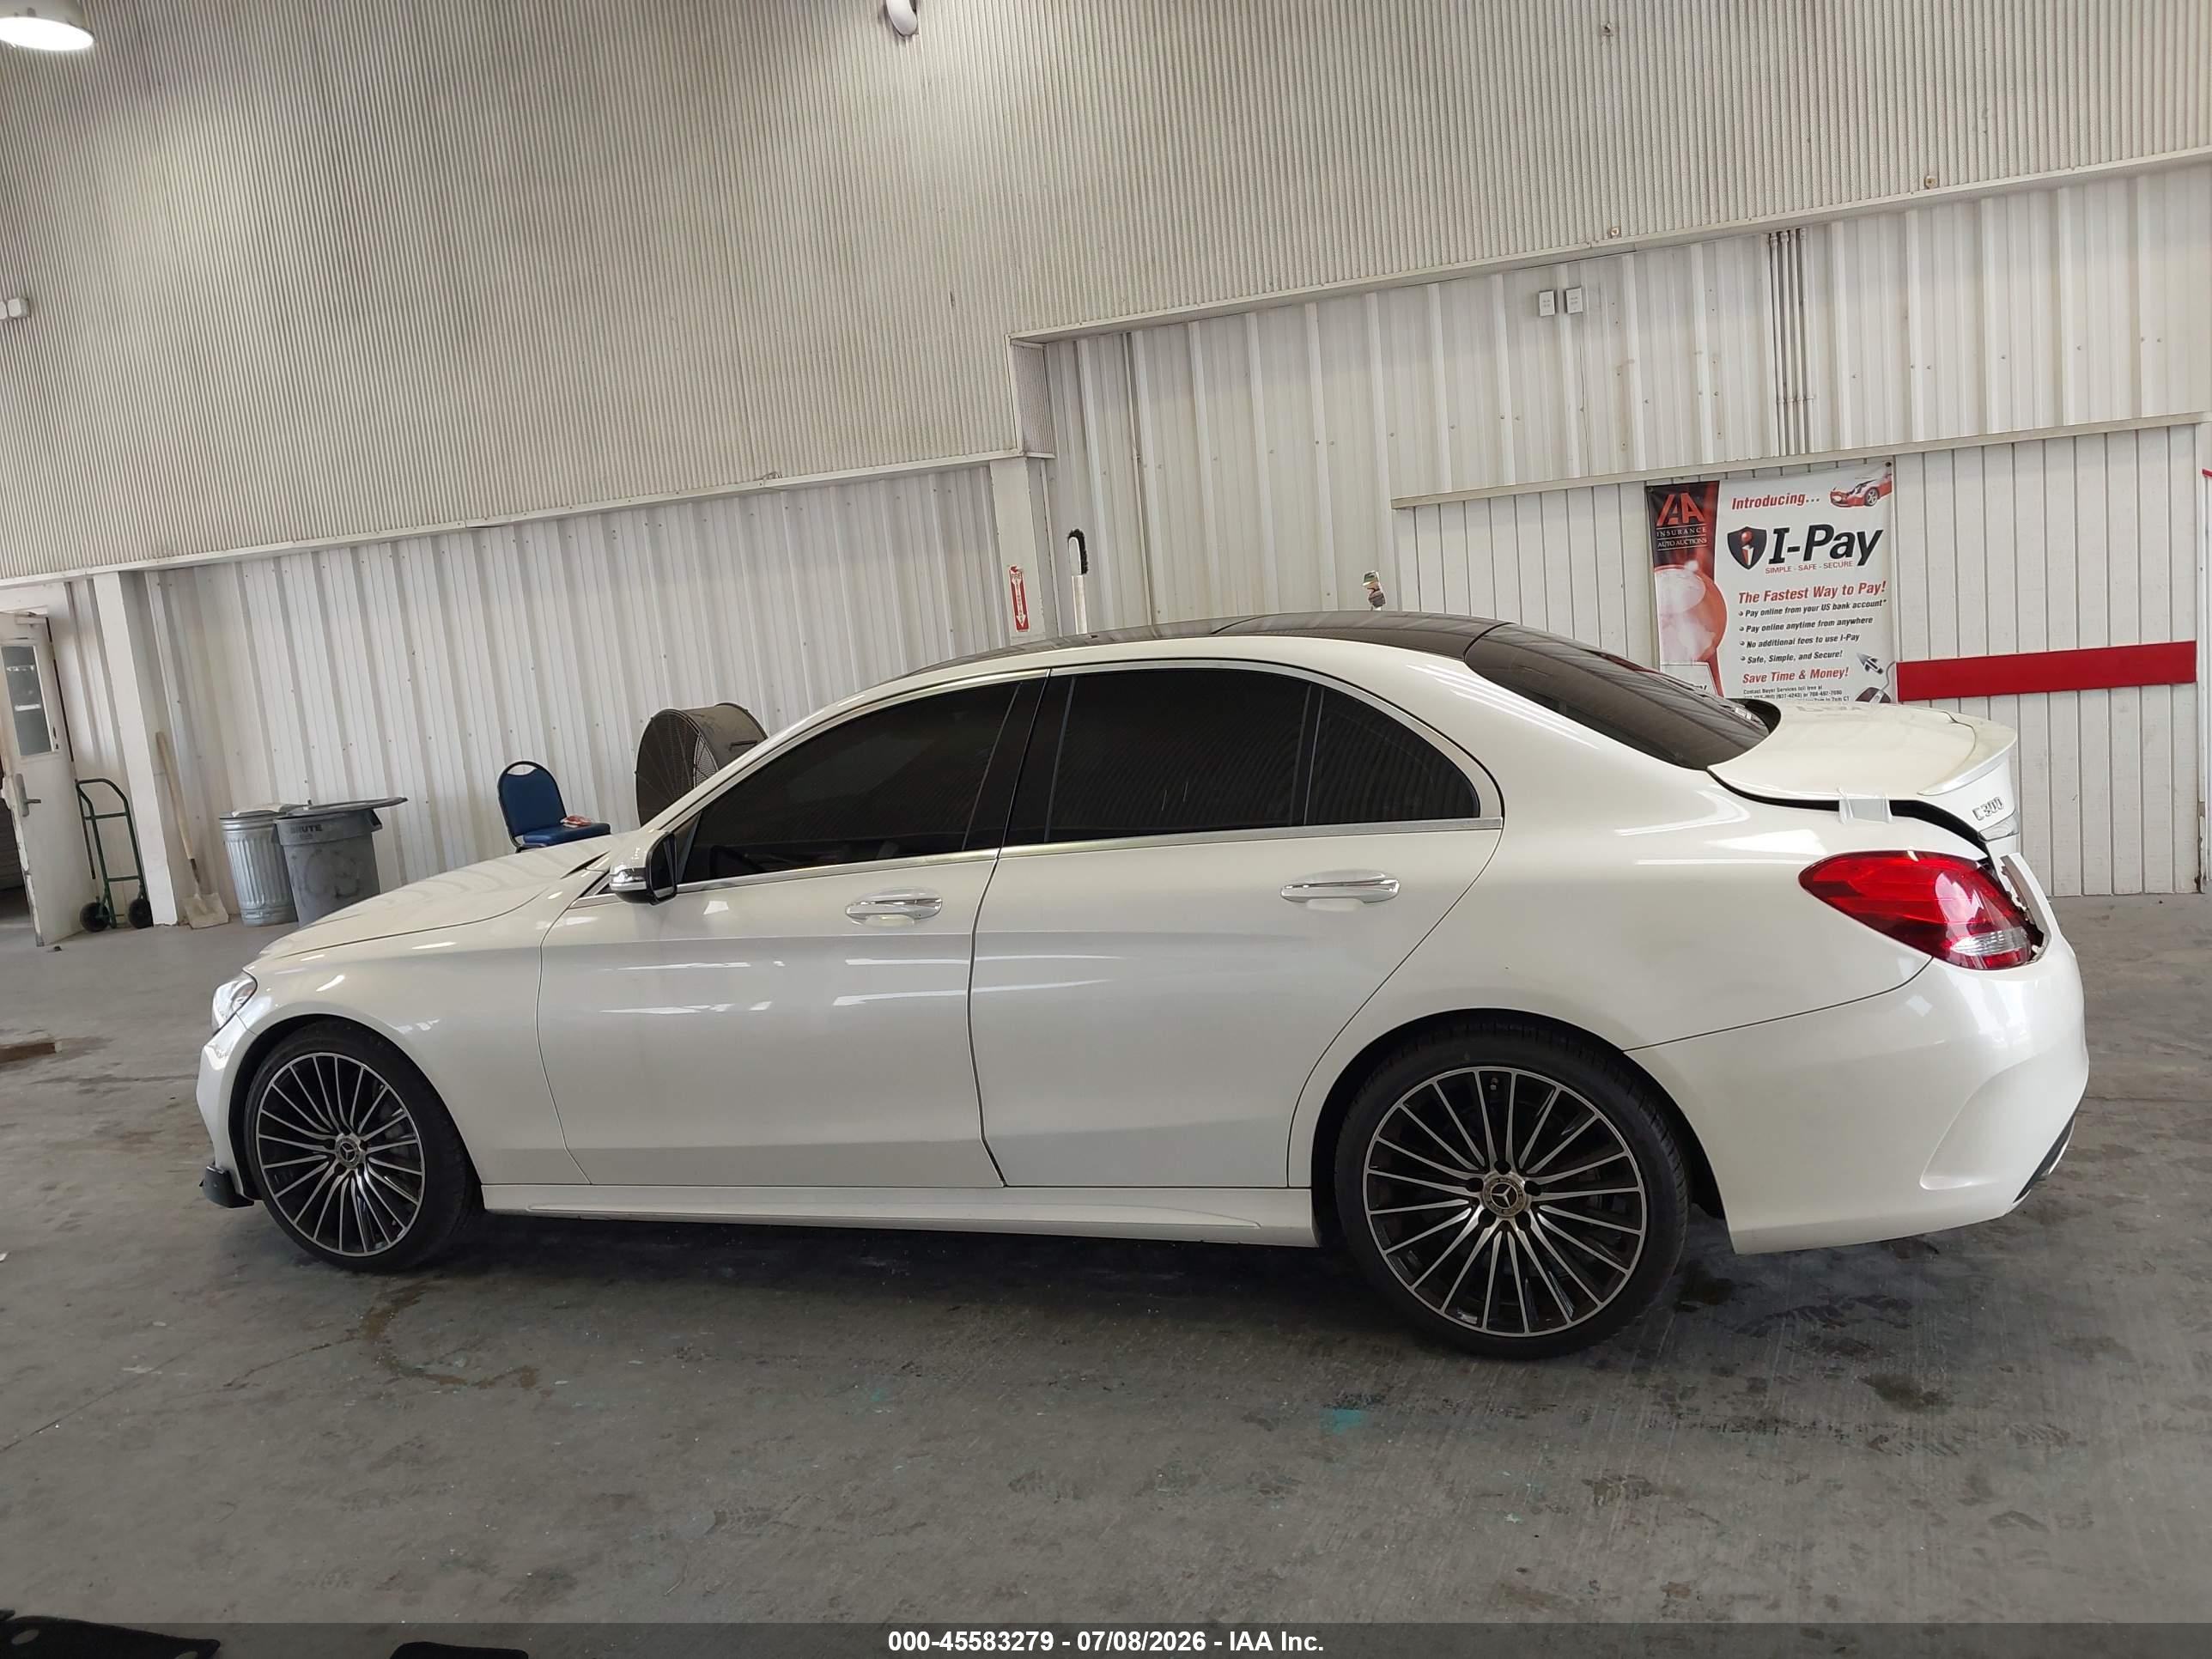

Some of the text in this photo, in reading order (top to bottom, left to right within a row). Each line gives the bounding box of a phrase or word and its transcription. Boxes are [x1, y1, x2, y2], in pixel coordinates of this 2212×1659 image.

[1732, 493, 1820, 510] Introducing...
[1656, 527, 1706, 537] INSURANCE
[1676, 538, 1707, 546] AUCTIONS
[1768, 524, 1884, 567] I-Pay
[1765, 566, 1792, 574] SIMPLE
[1798, 563, 1818, 572] SAFE
[1823, 561, 1854, 569] SECURE
[1739, 580, 1887, 604] The Fastest Way to Pay!
[1745, 609, 1759, 618] Pay
[1760, 608, 1784, 617] online
[1784, 605, 1802, 614] from
[1803, 605, 1820, 615] your
[1820, 603, 1832, 611] US
[1832, 602, 1850, 611] bank
[1746, 617, 1874, 634] Pay online anytime from anywhere
[1758, 637, 1796, 647] additional
[1839, 633, 1861, 642] I-Pay
[1747, 649, 1844, 665] Safe, Simple, and Secure!
[1742, 666, 1850, 684] Save Time & Money!
